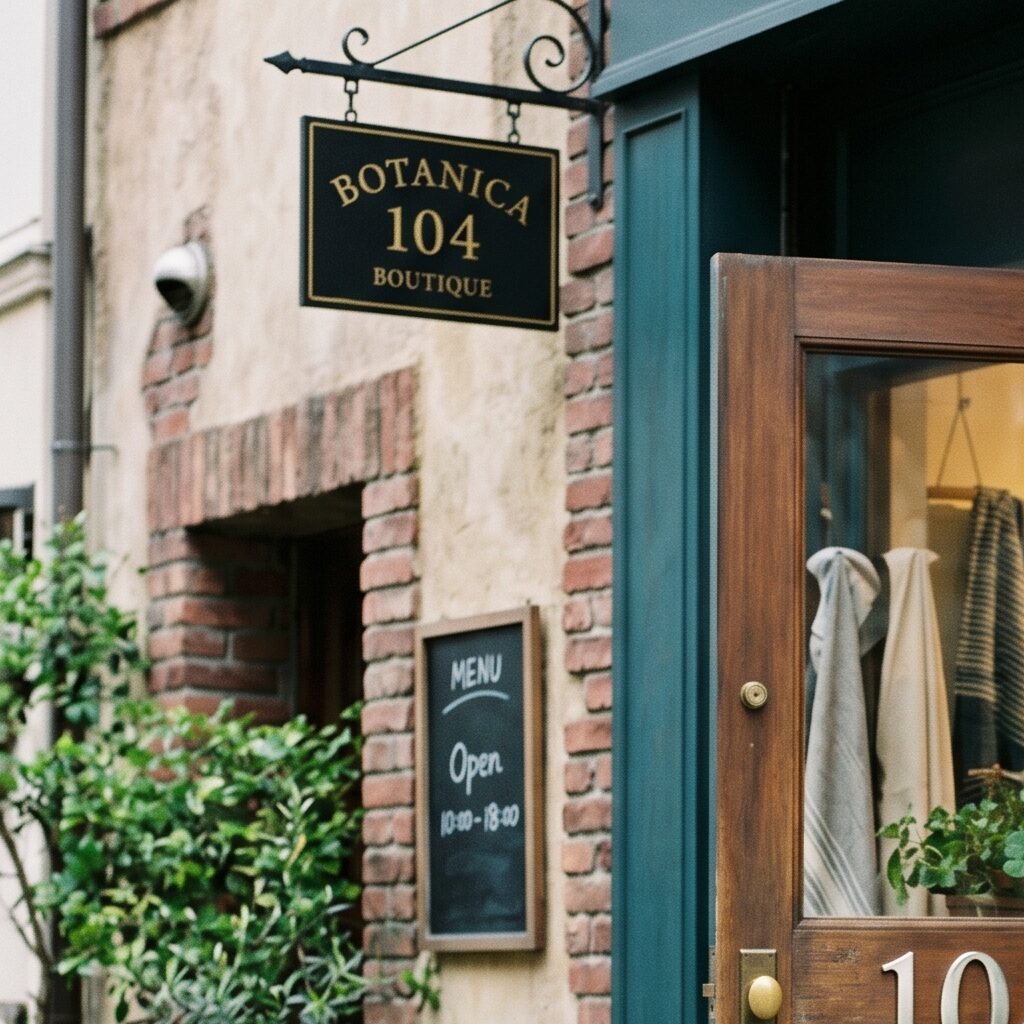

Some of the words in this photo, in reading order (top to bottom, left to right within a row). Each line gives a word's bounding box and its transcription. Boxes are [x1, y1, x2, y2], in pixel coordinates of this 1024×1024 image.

[329, 156, 531, 227] BOTANICA
[386, 205, 481, 262] 104
[372, 265, 494, 299] BOUTIQUE
[450, 652, 503, 691] MENU
[449, 741, 504, 796] Open
